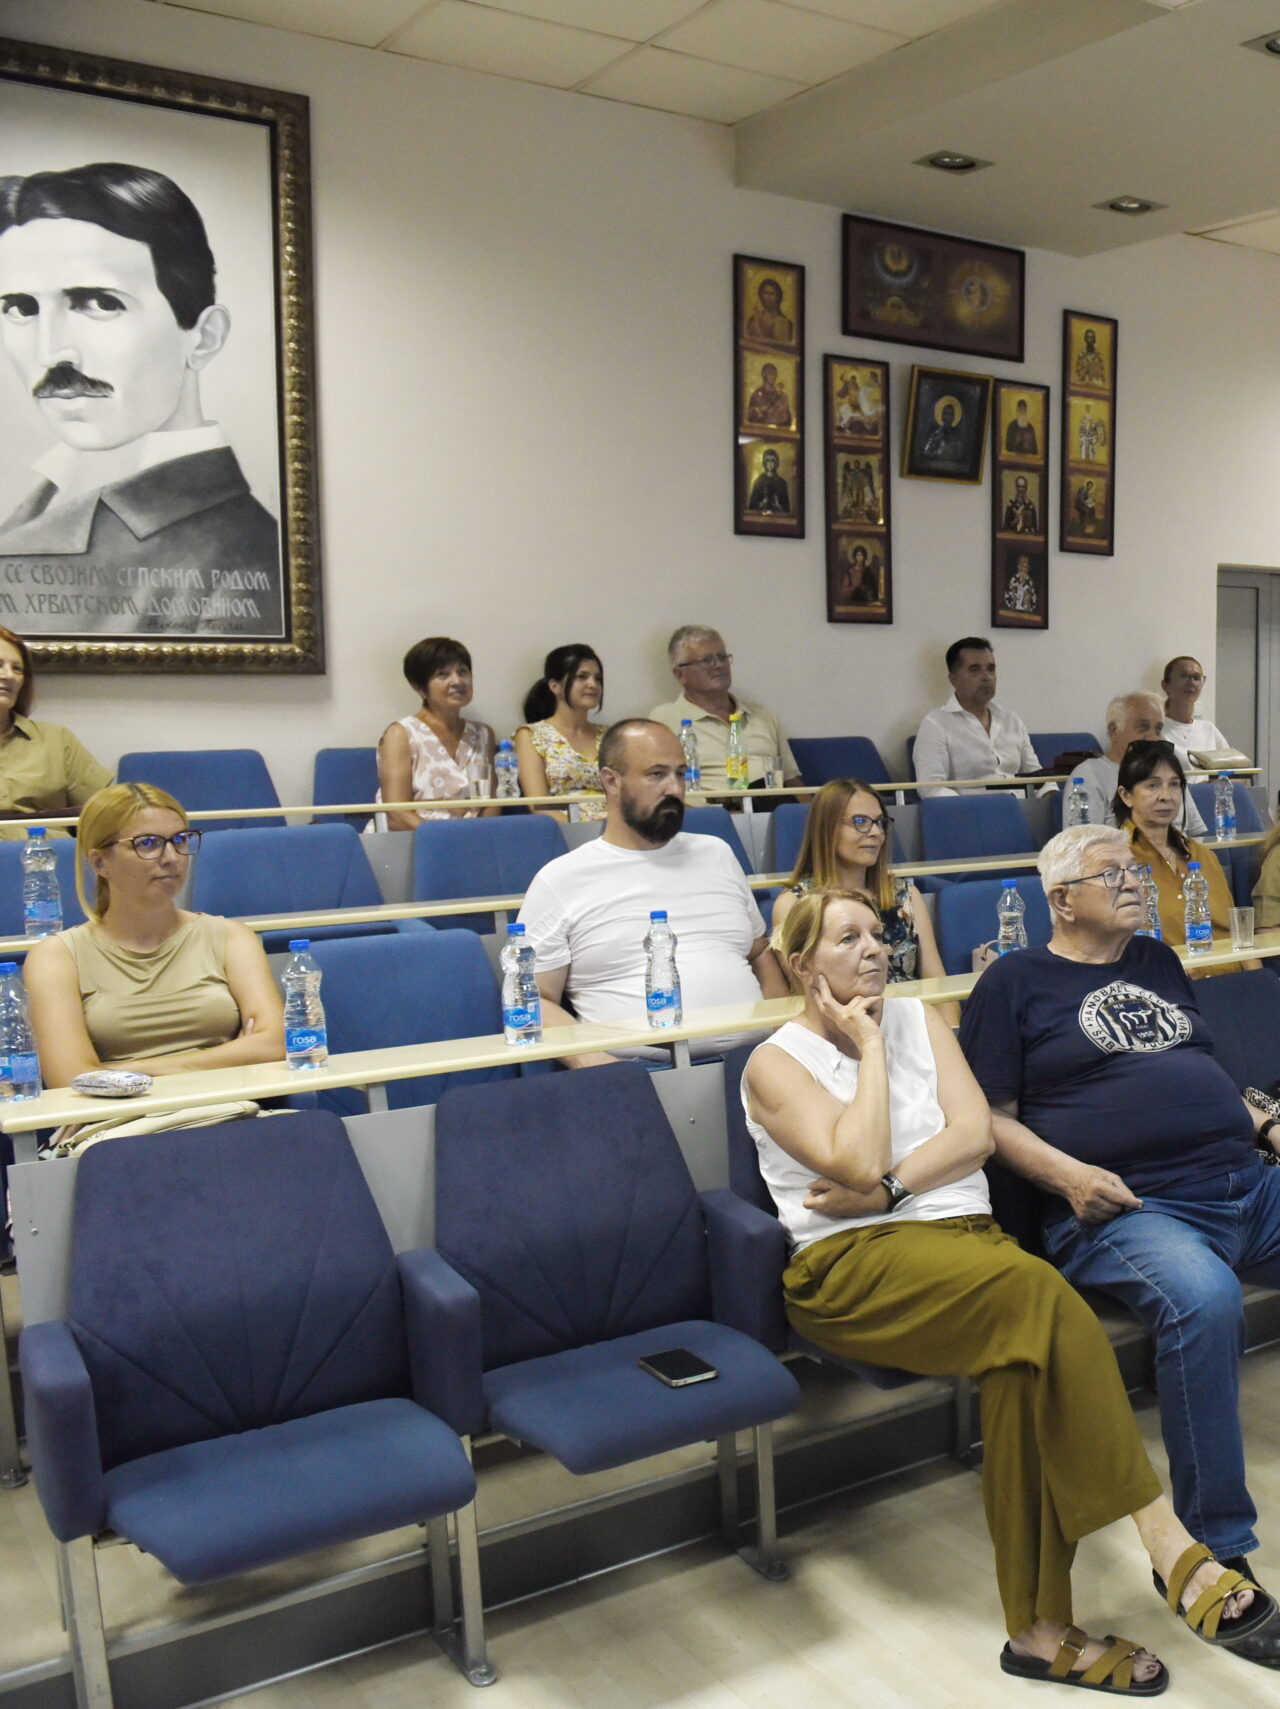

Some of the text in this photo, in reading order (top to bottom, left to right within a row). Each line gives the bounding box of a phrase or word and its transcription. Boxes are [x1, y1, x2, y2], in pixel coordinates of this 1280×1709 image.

[211, 569, 271, 590] РОДОМ
[25, 593, 140, 615] ХРВАТСКОМ
[648, 997, 667, 1005] rosa
[1085, 984, 1131, 1021] HANDBALL
[510, 1013, 531, 1022] rosa
[292, 1035, 317, 1044] rosa
